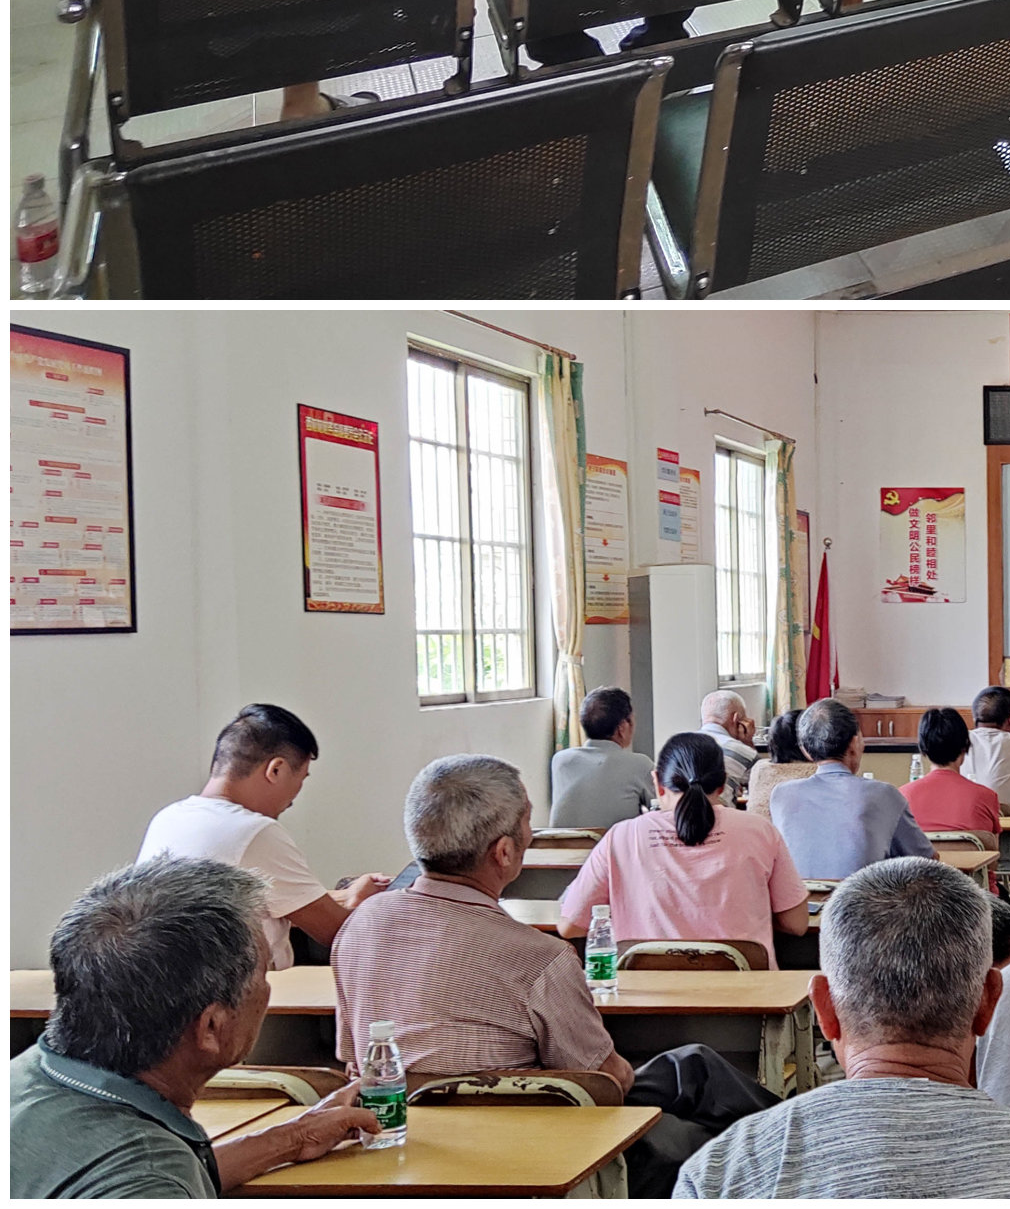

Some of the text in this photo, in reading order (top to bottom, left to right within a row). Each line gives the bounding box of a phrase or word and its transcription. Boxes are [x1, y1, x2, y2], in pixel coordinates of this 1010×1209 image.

[908, 507, 921, 586] 做文明公民榜样
[925, 512, 938, 580] 邻里和睦相处
